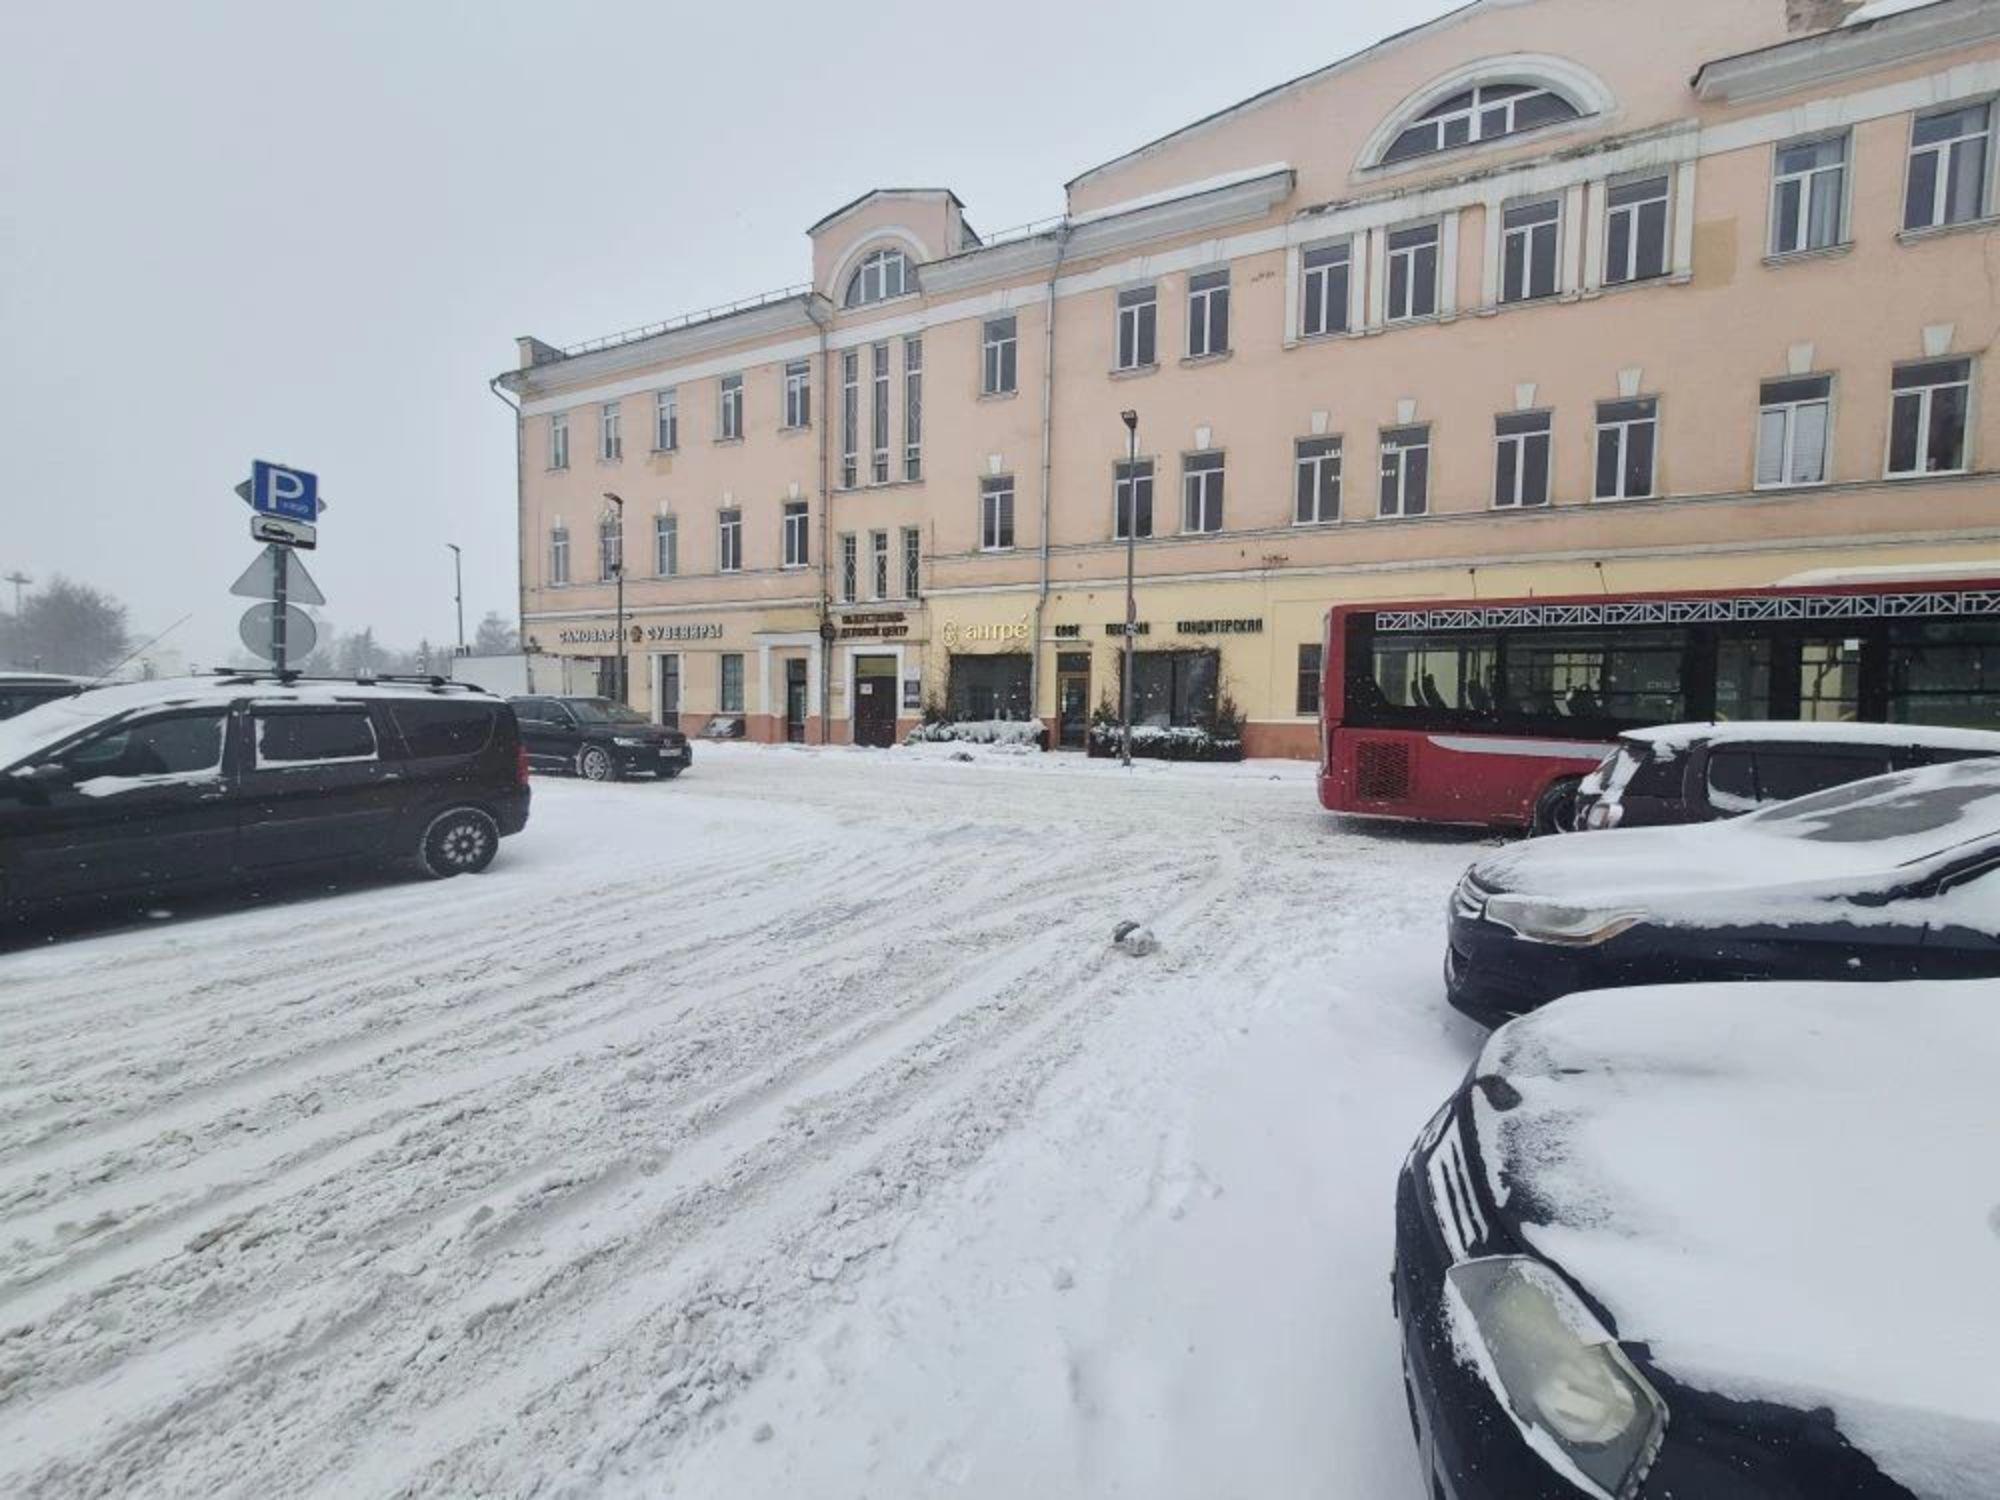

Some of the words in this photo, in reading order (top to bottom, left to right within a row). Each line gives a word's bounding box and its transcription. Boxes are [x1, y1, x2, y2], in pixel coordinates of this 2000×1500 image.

[267, 468, 305, 509] P
[646, 623, 723, 641] СУВЕНИРЫ
[1176, 618, 1263, 635] КОНДИТЕРСКАЯ
